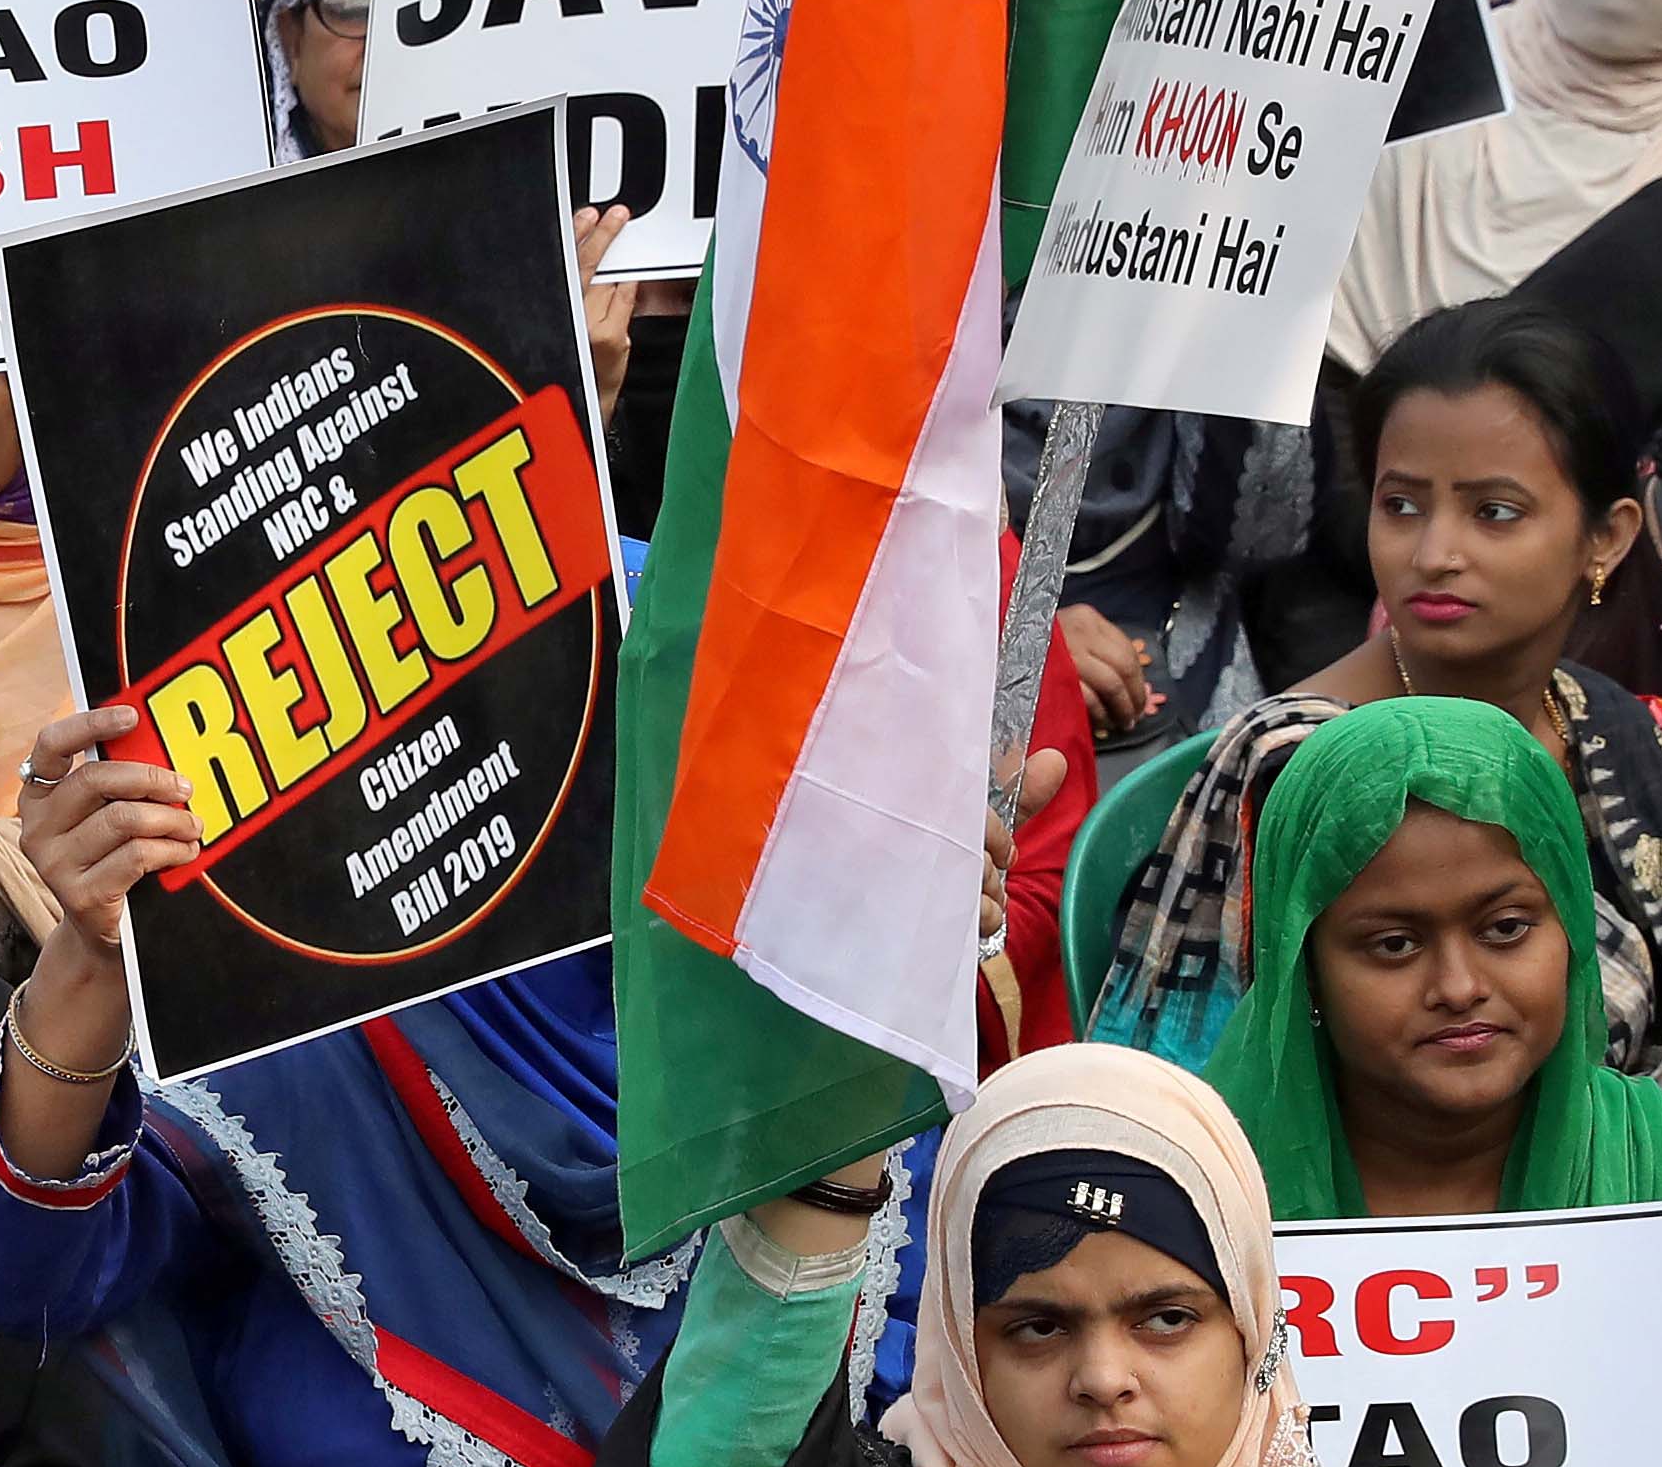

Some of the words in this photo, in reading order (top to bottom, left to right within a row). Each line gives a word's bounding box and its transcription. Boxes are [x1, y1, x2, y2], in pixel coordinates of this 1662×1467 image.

[1323, 0, 1414, 86] Hai
[1133, 75, 1248, 187] KHOON
[1246, 99, 1305, 183] Se
[1206, 215, 1286, 297] Hai
[161, 439, 305, 572] Standing
[291, 360, 422, 480] Against
[179, 428, 242, 489] We
[230, 343, 358, 457] Indians
[260, 500, 332, 565] NRC
[328, 481, 360, 519] &
[146, 427, 561, 849] REJECT
[343, 738, 523, 903] Amendment
[357, 712, 463, 815] Citizen
[390, 876, 448, 938] Bill
[442, 812, 519, 912] 2019
